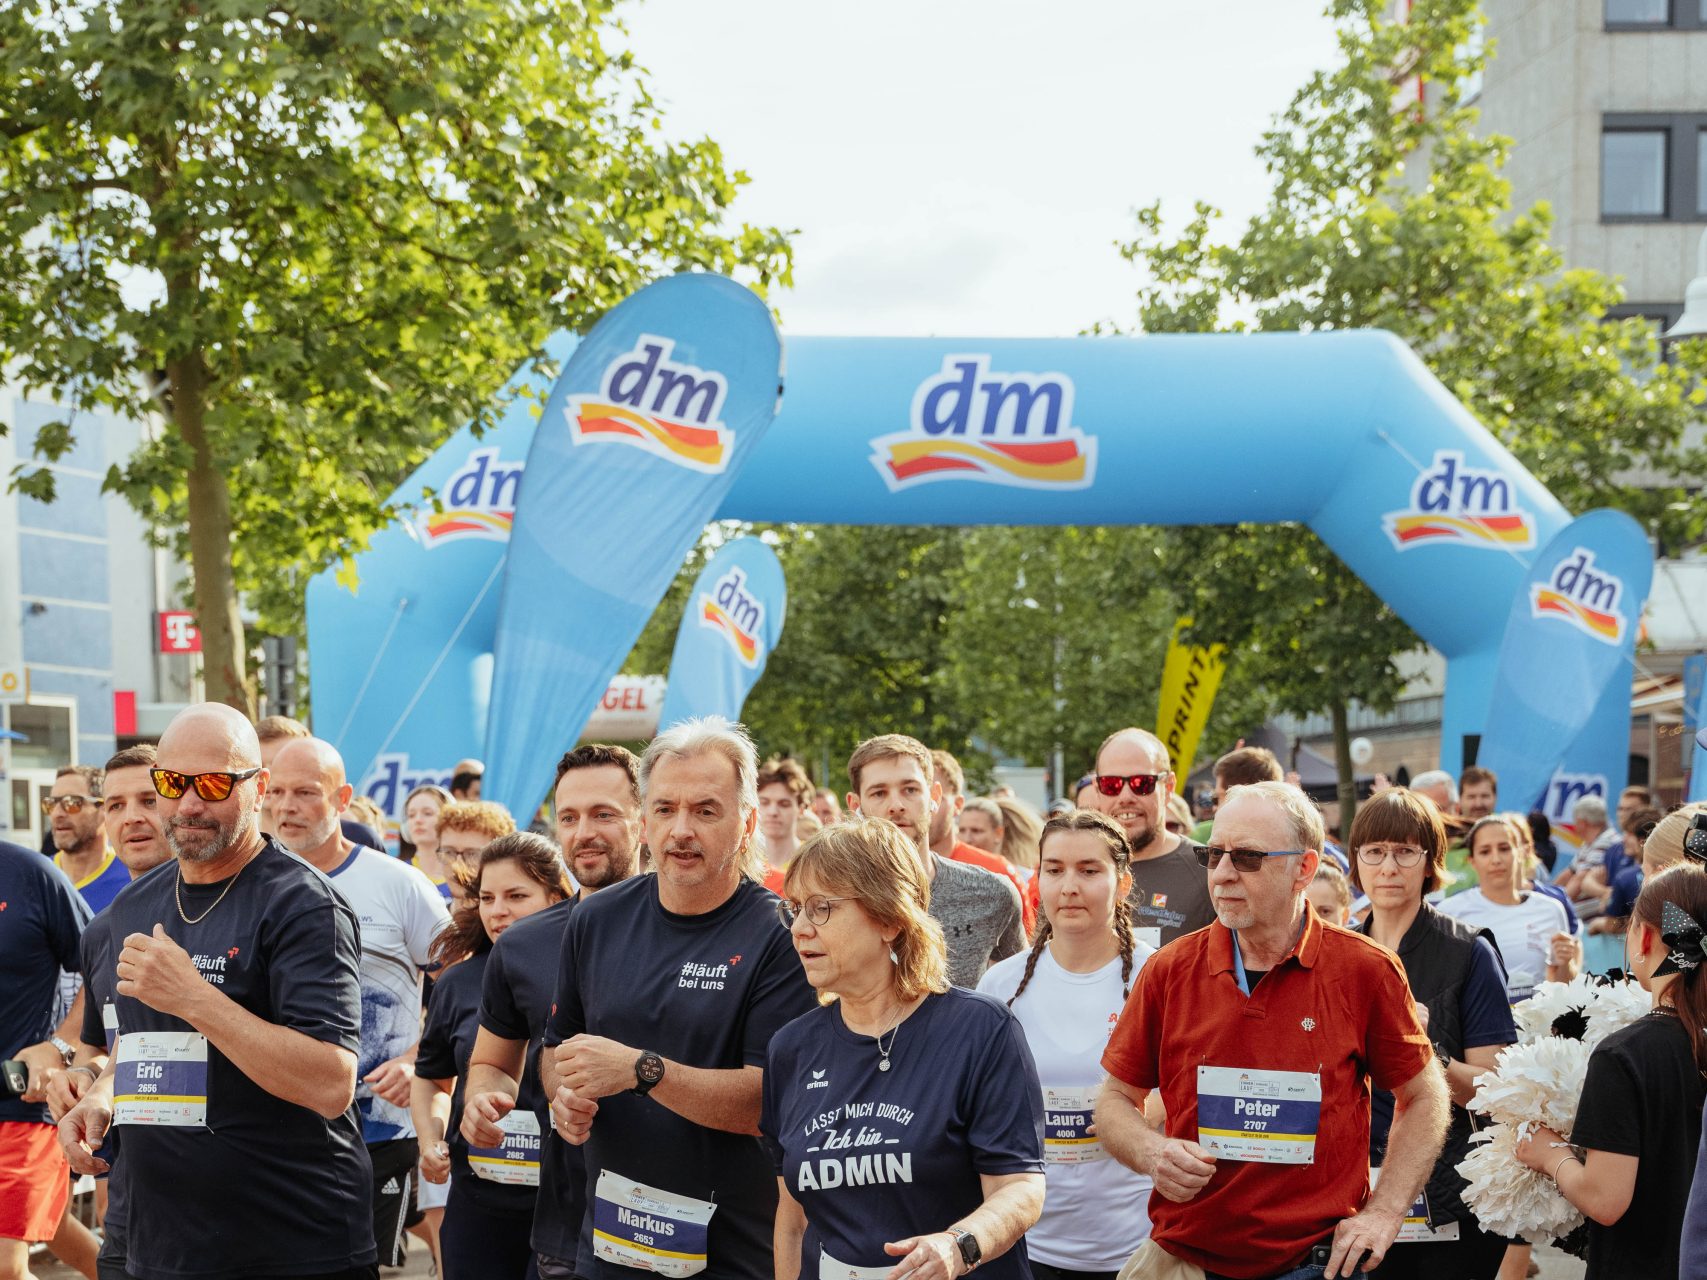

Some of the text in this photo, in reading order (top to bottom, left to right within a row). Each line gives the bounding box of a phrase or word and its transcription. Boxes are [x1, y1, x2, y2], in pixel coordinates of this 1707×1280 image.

[609, 344, 719, 424] dm
[922, 362, 1063, 436] dm
[1418, 458, 1509, 511] dm
[1555, 554, 1617, 610] dm
[718, 574, 759, 632] dm
[600, 687, 647, 711] GEL
[191, 954, 226, 971] #läuft
[681, 961, 728, 978] #läuft
[678, 976, 724, 990] bei uns
[136, 1062, 163, 1079] Eric
[137, 1083, 157, 1093] 2656
[806, 1080, 829, 1090] erima
[1234, 1098, 1280, 1117] Peter
[804, 1102, 914, 1136] LASST MICH DURCH
[1045, 1111, 1085, 1126] Laura
[1243, 1120, 1267, 1131] 2707
[500, 1134, 541, 1150] ynthia
[822, 1126, 883, 1150] Ich bin
[1056, 1129, 1075, 1138] 4000
[798, 1152, 913, 1192] ADMIN
[617, 1206, 675, 1236] Markus
[633, 1232, 654, 1246] 2653
